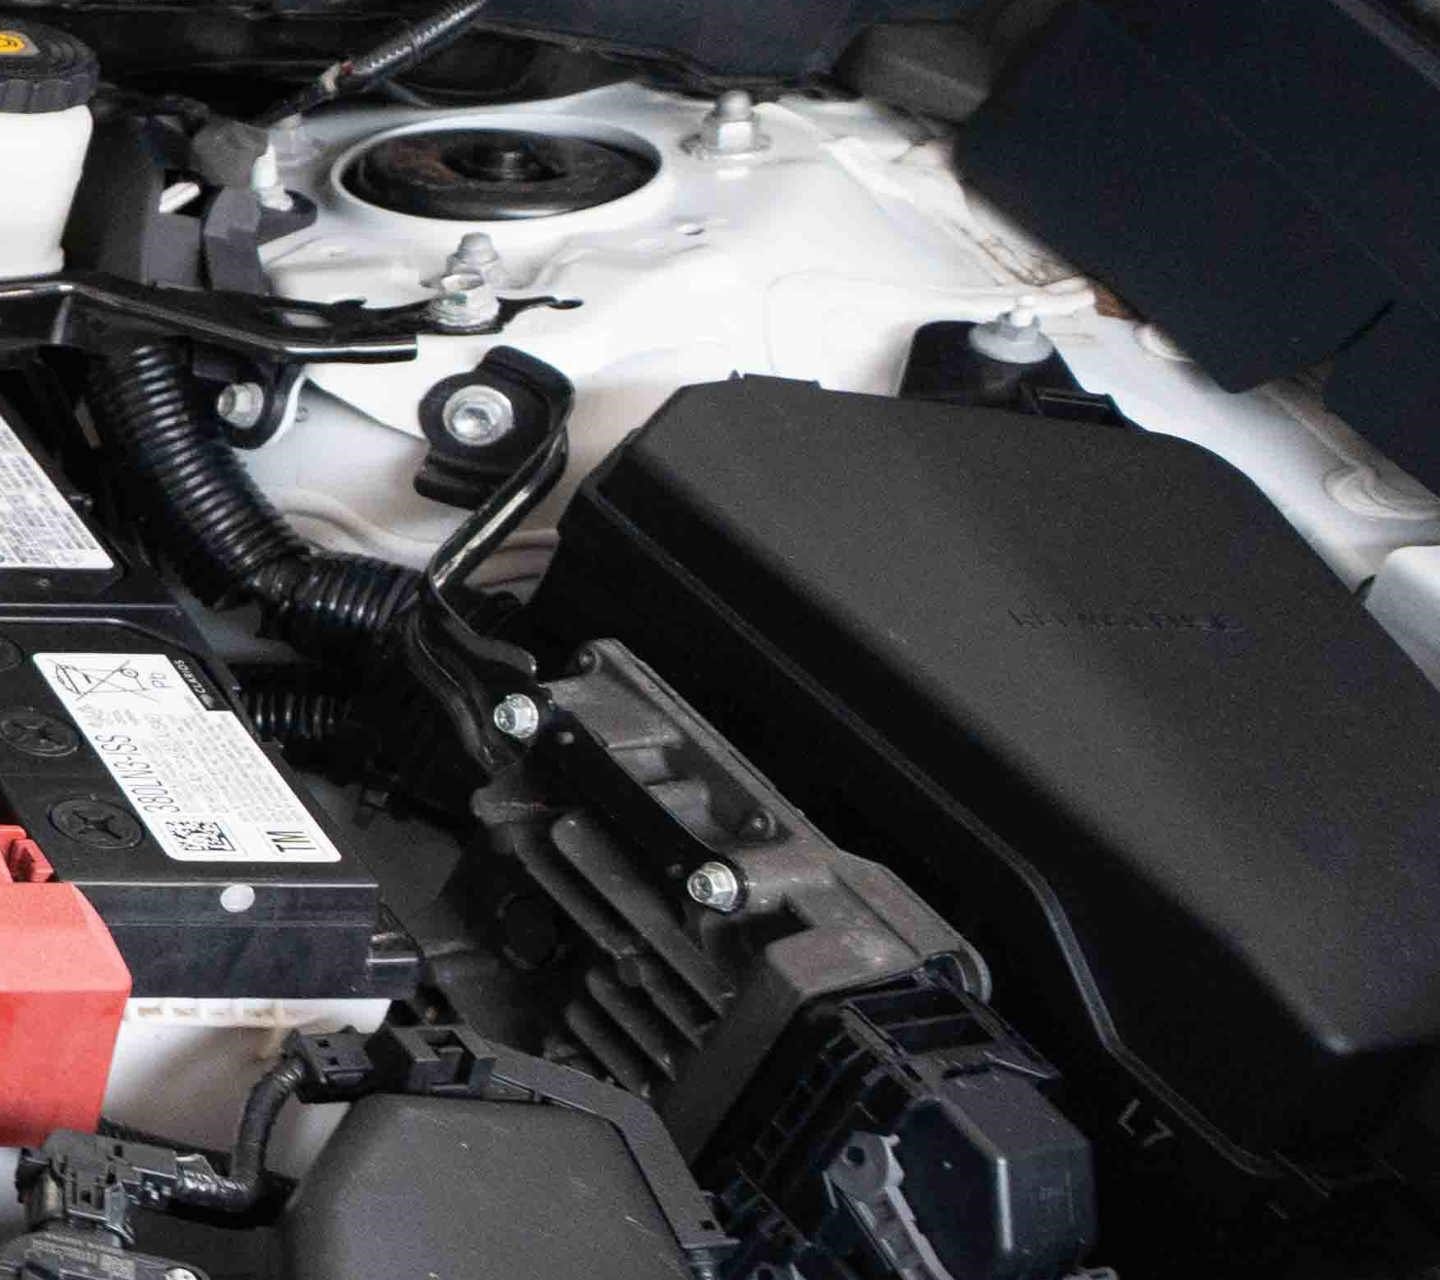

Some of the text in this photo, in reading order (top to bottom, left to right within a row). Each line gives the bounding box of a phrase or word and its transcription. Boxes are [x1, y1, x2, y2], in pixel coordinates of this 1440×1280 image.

[151, 671, 174, 689] Pb
[173, 659, 207, 696] CLARIOS
[95, 733, 181, 815] 380LN3-ISS
[265, 831, 317, 853] TM
